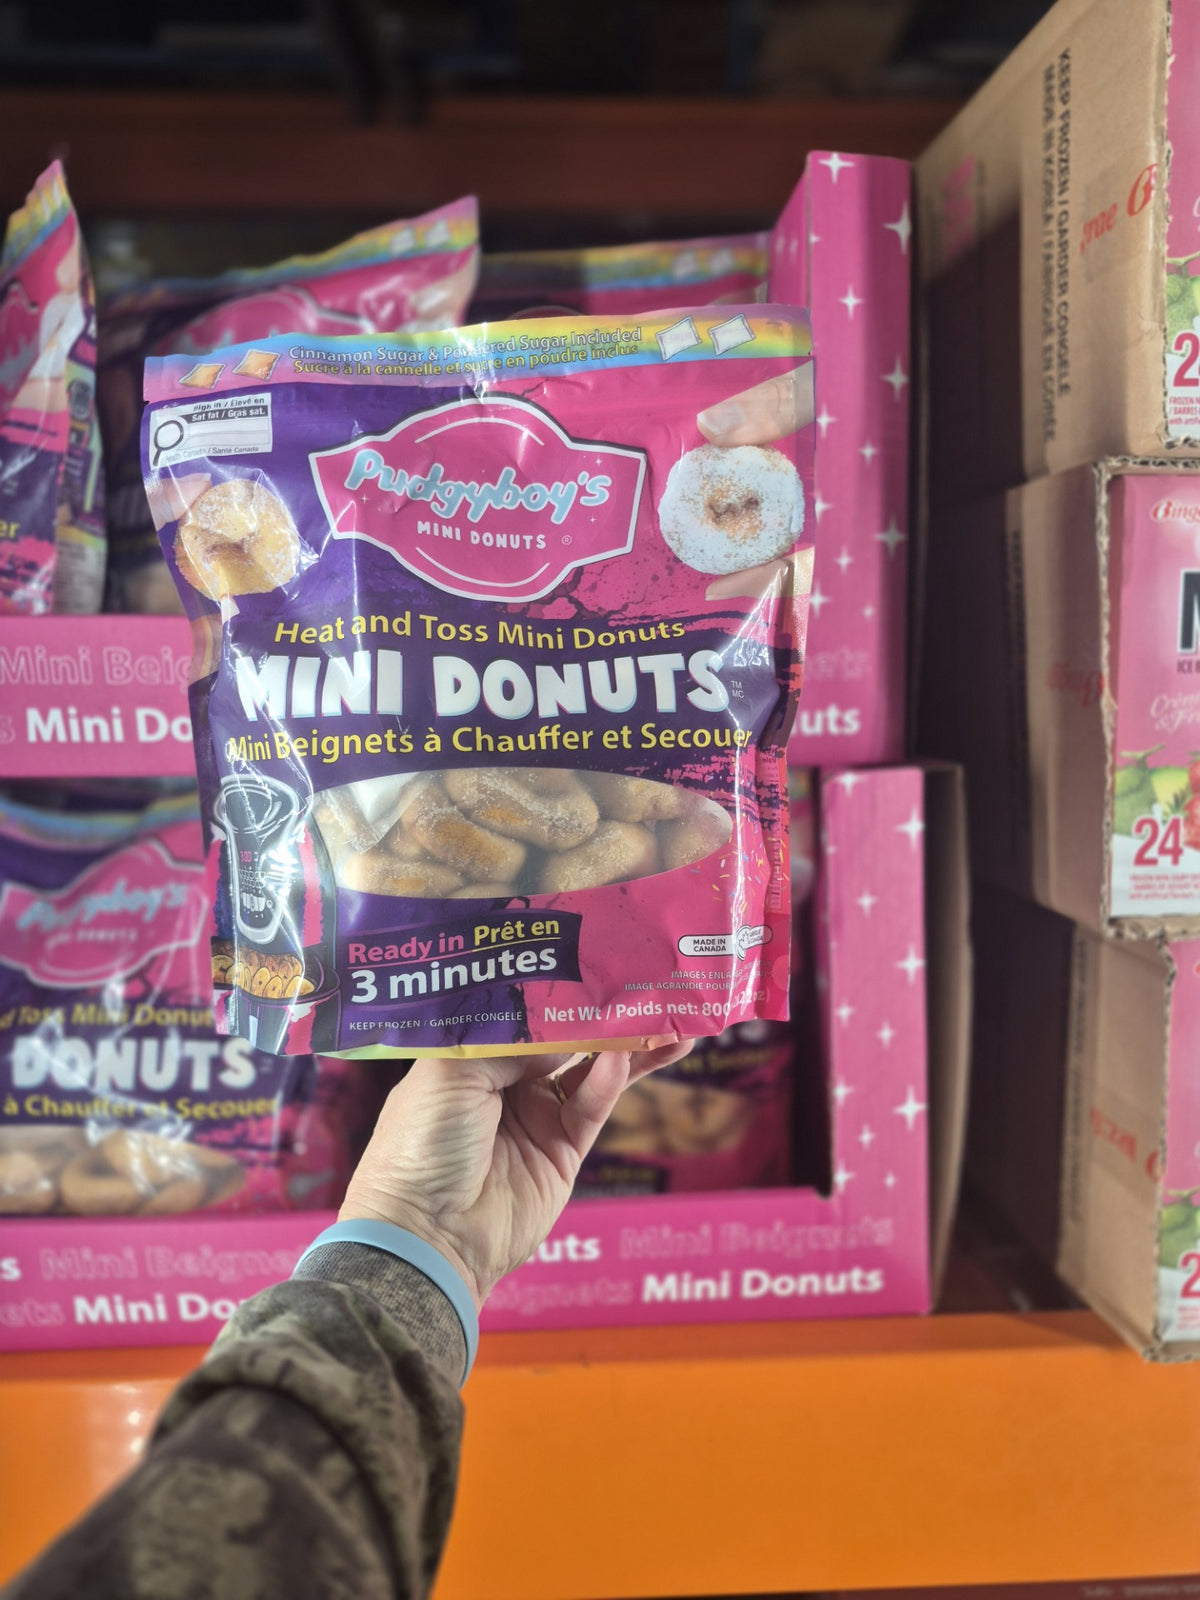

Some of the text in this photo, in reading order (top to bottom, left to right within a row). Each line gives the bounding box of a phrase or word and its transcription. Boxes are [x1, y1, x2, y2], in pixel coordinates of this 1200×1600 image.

[289, 345, 374, 361] Cinnamon
[376, 346, 425, 365] Sugar
[428, 348, 439, 361] &
[520, 332, 567, 356] Sugar
[571, 326, 642, 347] Included
[294, 360, 339, 374] Sucre
[354, 360, 372, 375] la
[374, 360, 442, 376] cannelle
[446, 361, 462, 375] et
[463, 355, 503, 373] sucre
[506, 354, 525, 368] en
[529, 348, 588, 369] poudre
[591, 342, 638, 359] inclus
[343, 449, 612, 525] Pudgyboy's
[416, 520, 461, 542] MINI
[470, 533, 547, 550] DONUTS
[274, 610, 686, 650] Heat and Toss Mini Donuts
[234, 649, 730, 723] MINI DONUTS
[26, 706, 125, 743] Mini
[226, 722, 752, 764] Mini Beignets à Chauffer et Secouer
[1132, 814, 1185, 868] 24
[348, 919, 561, 964] Ready in Prêt en
[692, 938, 717, 946] MADE
[693, 945, 727, 953] CANADA
[350, 947, 558, 1004] 3 minutes
[624, 981, 656, 991] IMAGE
[656, 981, 704, 991] AGRANDIE
[671, 970, 707, 980] IMAGES
[349, 1021, 376, 1031] KEEP
[378, 1019, 421, 1030] FROZEN
[429, 1014, 472, 1028] GARDER
[543, 1005, 575, 1022] Net
[577, 1004, 603, 1021] Wt
[615, 1000, 663, 1018] Poids
[666, 1000, 699, 1016] net:
[10, 1035, 258, 1092] DONUTS
[642, 1271, 731, 1303] Mini
[740, 1266, 885, 1299] Donuts
[72, 1292, 169, 1325] Mini
